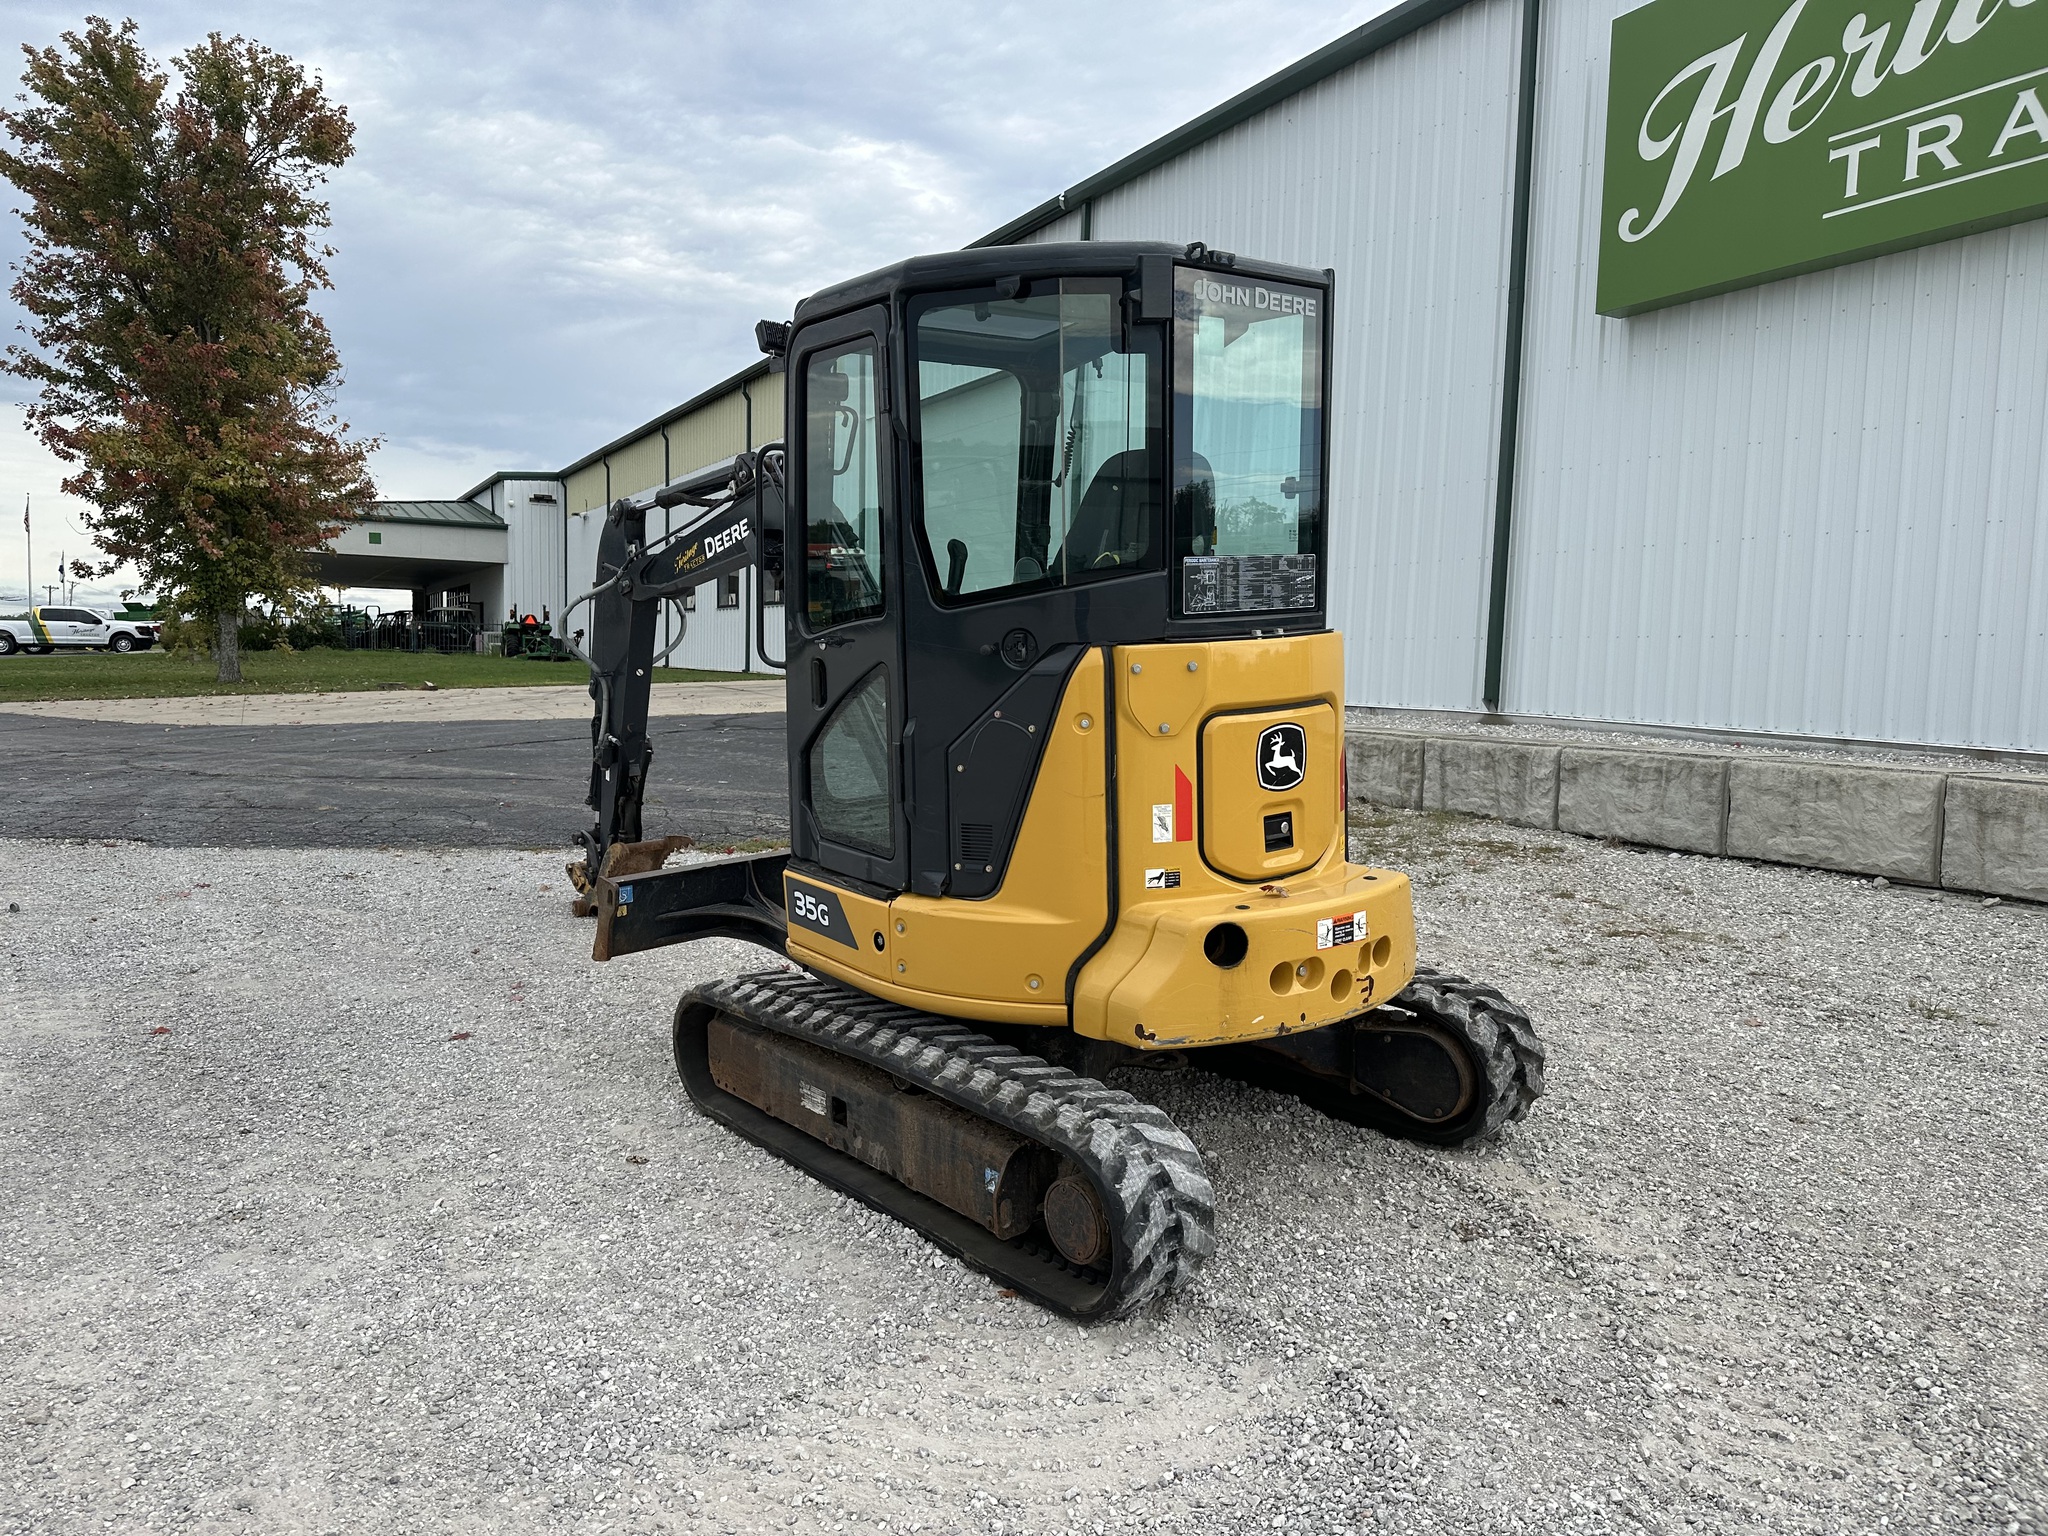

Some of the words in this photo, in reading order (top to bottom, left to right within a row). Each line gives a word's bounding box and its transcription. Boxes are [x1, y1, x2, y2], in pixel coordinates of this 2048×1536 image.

[1194, 278, 1250, 307] JOHN
[1254, 286, 1317, 317] DEERE
[703, 517, 750, 560] DEERE
[793, 890, 830, 927] 35G
